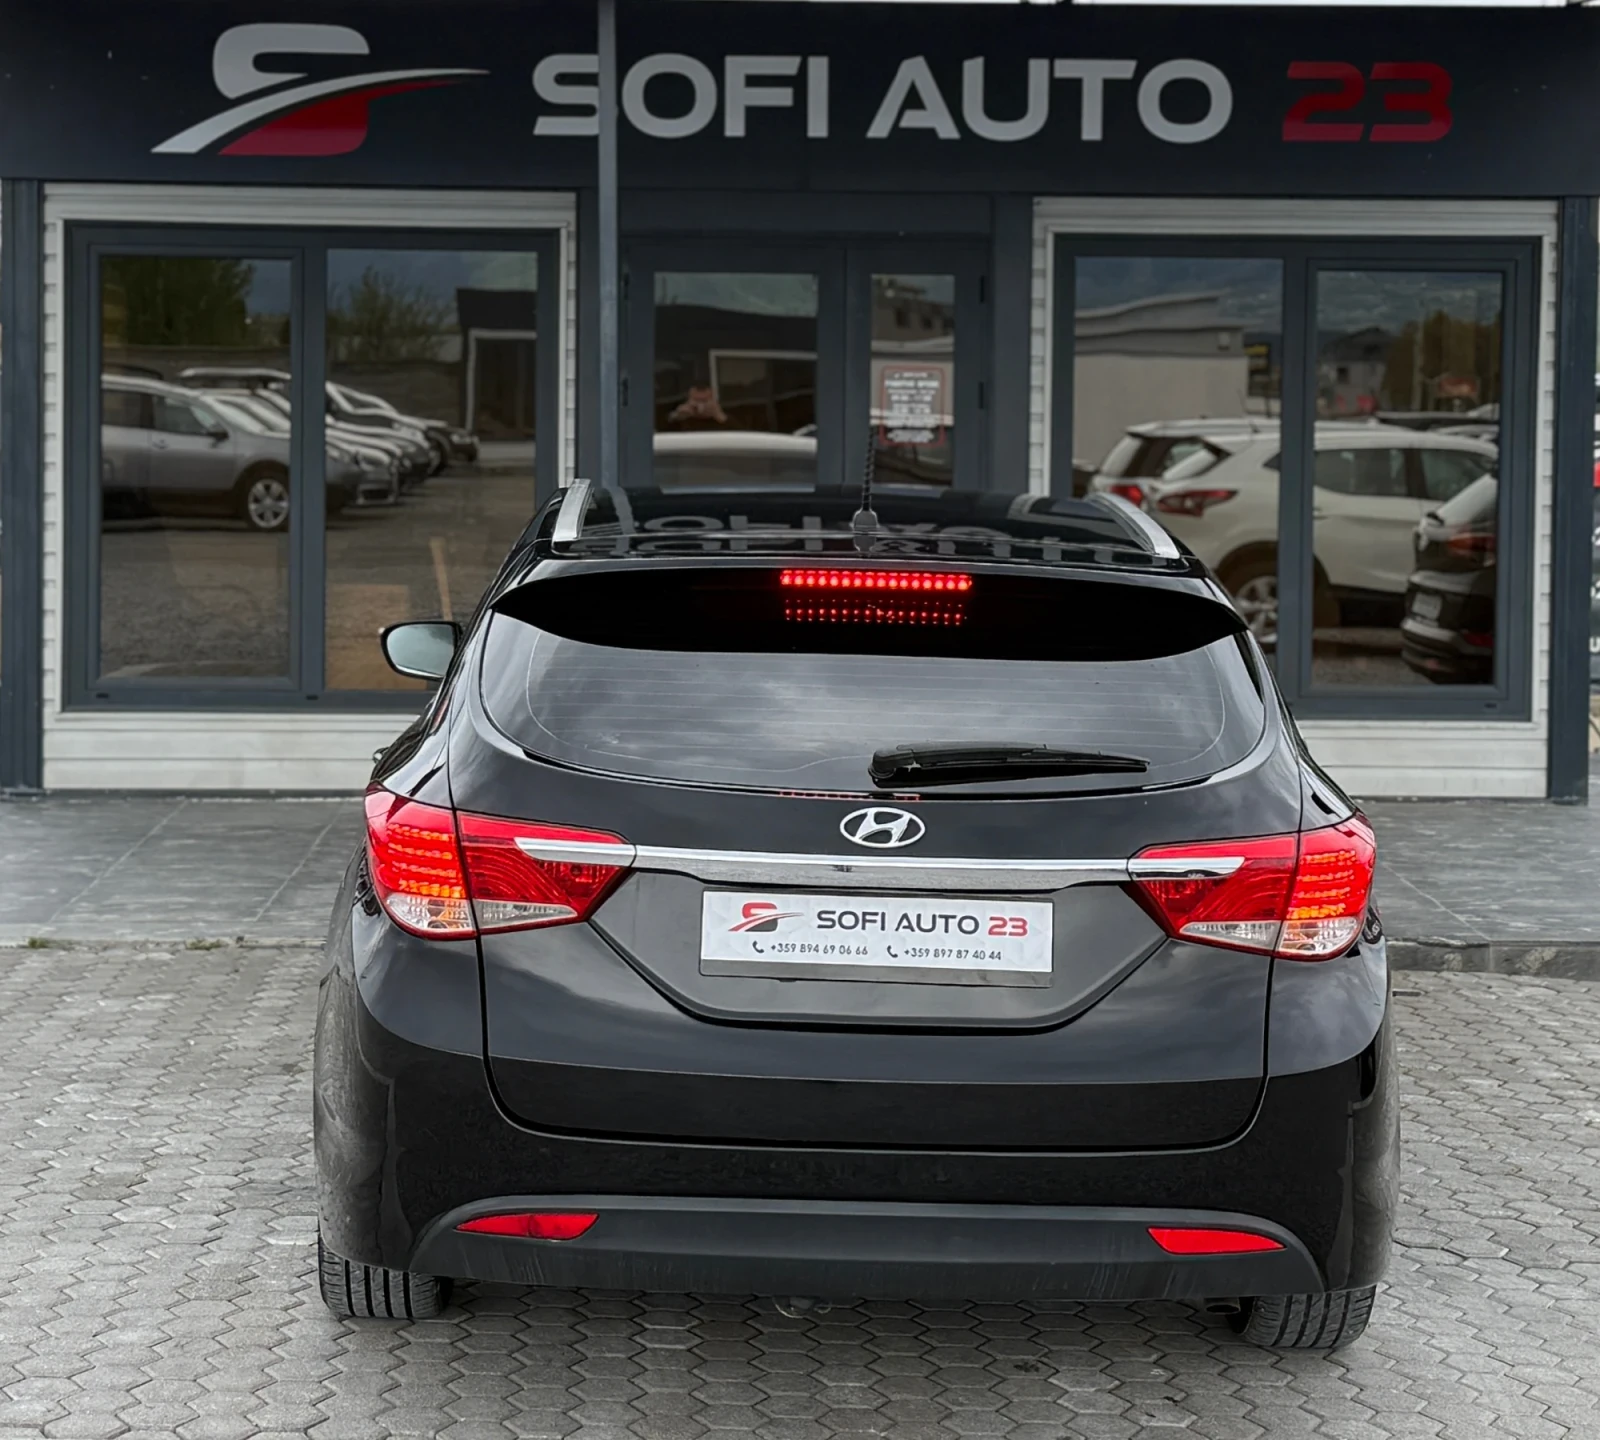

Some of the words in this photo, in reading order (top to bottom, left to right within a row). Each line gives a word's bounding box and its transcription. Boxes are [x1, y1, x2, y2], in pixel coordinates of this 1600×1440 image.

[532, 53, 829, 139] SOFI
[866, 55, 1234, 144] AUTO
[1281, 60, 1454, 143] 23
[816, 909, 886, 932] SOFI
[894, 911, 980, 935] AUTO
[987, 916, 1029, 937] 23
[770, 942, 797, 953] +359
[799, 943, 820, 954] 894
[822, 944, 836, 955] 69
[838, 945, 852, 956] 06
[854, 946, 869, 956] 66
[903, 947, 930, 958] +359
[933, 948, 953, 959] 897
[955, 949, 970, 960] 87
[971, 949, 986, 961] 40
[988, 950, 1003, 961] 44
